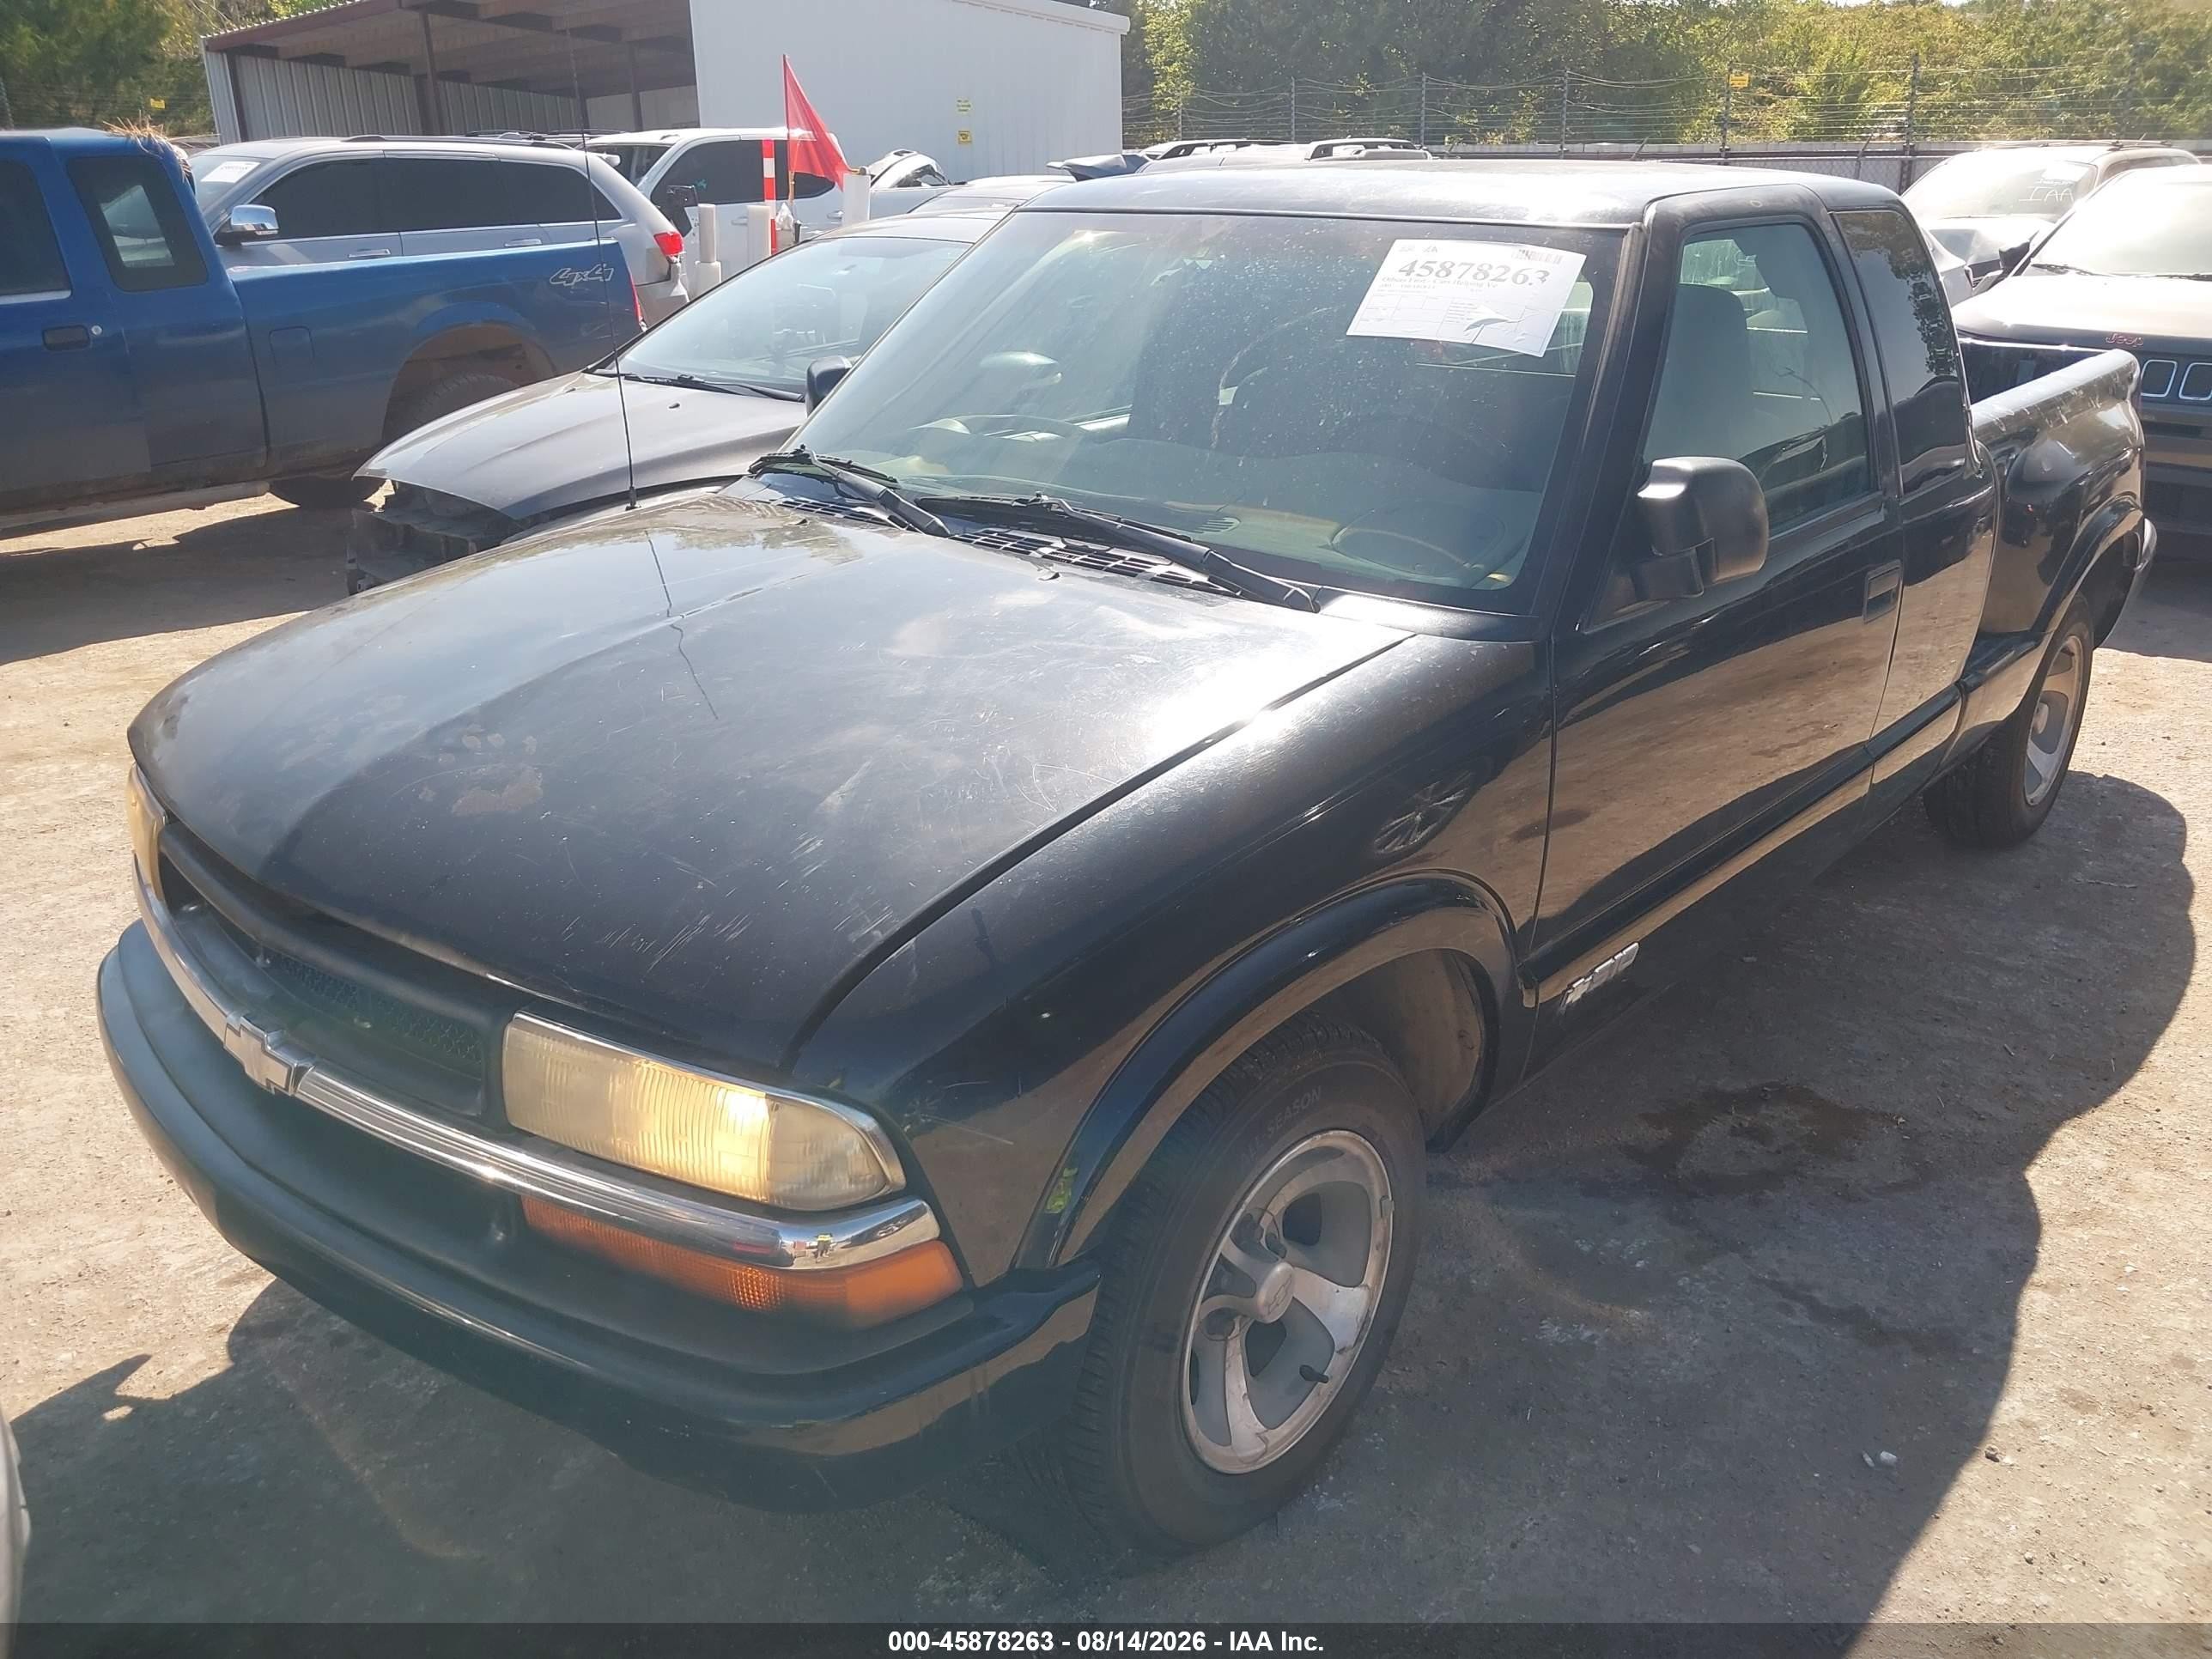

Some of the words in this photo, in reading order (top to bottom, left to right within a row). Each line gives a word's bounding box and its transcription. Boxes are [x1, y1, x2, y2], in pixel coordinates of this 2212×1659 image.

[2018, 185, 2075, 204] IAA
[550, 264, 614, 286] 4x4
[1398, 259, 1551, 286] 45878263
[2106, 333, 2144, 348] Jeep
[1267, 1085, 1322, 1139] SEASON
